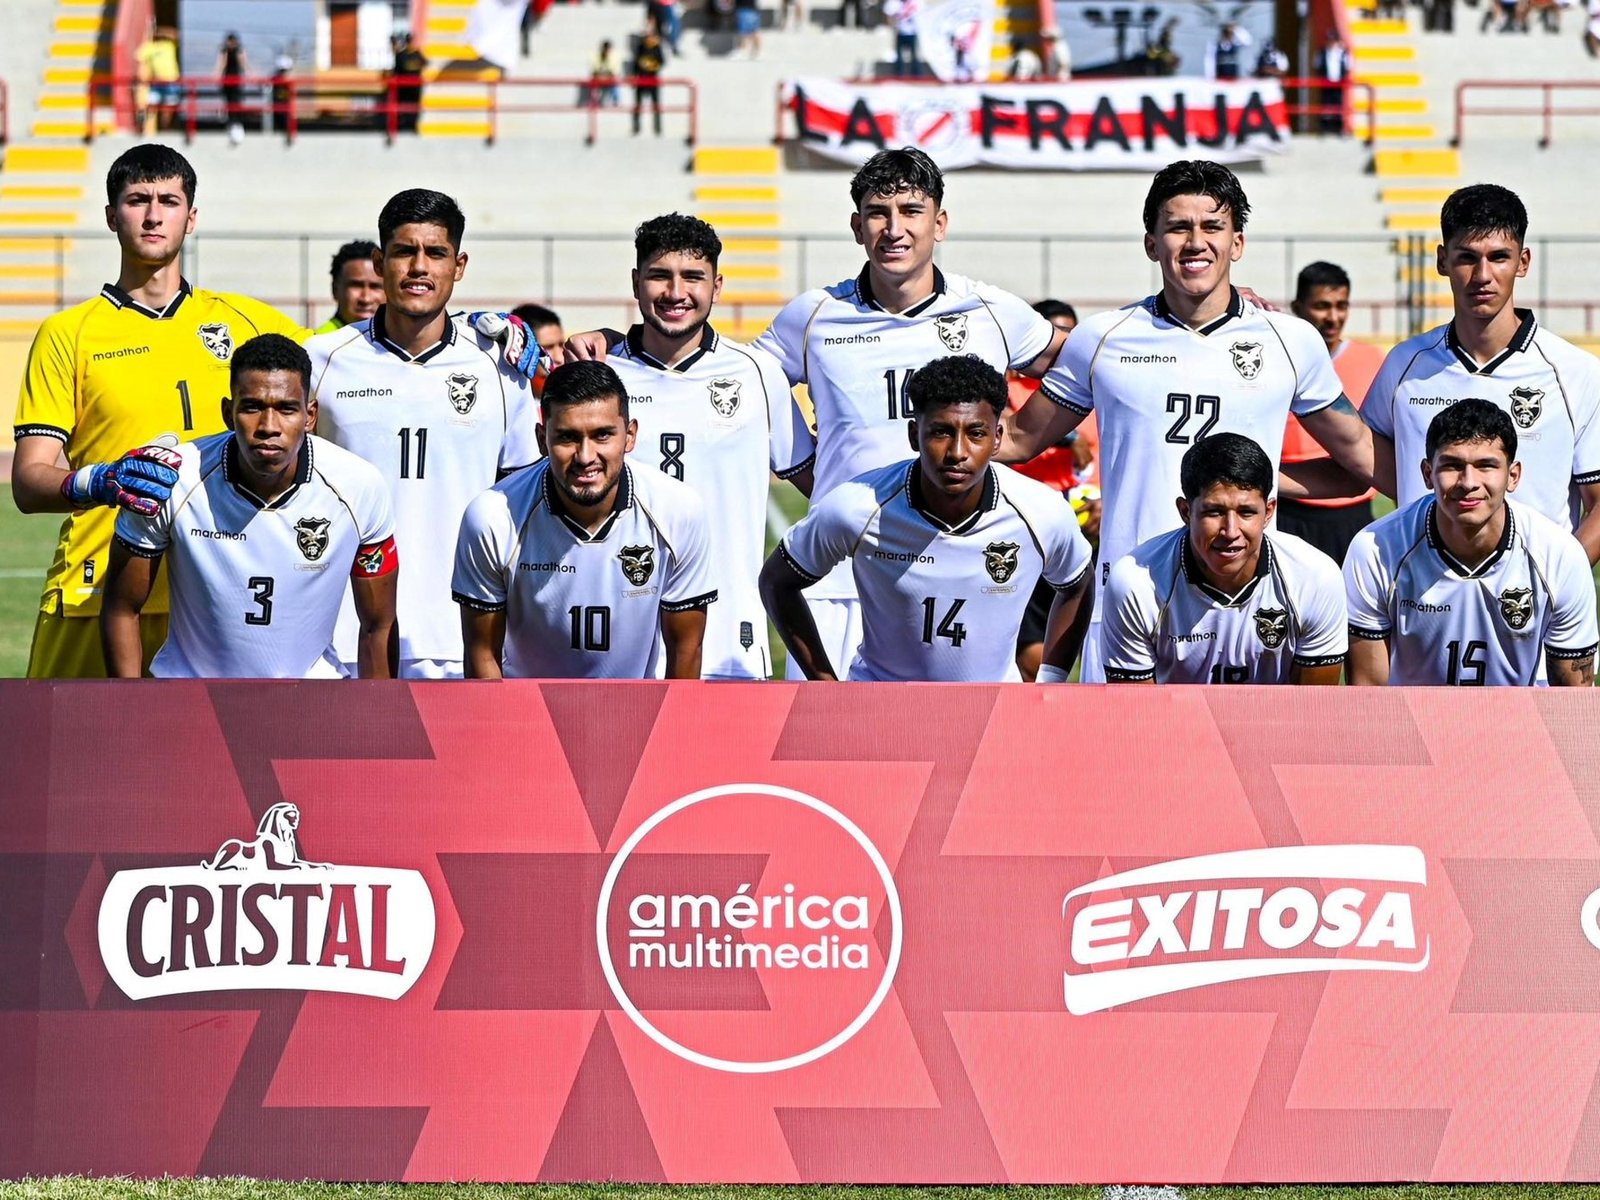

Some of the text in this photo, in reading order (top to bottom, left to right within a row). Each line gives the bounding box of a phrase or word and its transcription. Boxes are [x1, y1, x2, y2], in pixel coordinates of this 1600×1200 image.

[794, 83, 1281, 151] LA FRANJA
[93, 345, 150, 361] marathon
[824, 334, 881, 346] marathon
[1120, 354, 1177, 365] marathon
[175, 380, 194, 431] 1
[336, 387, 393, 399] marathon
[1165, 393, 1221, 444] 22
[398, 427, 428, 479] 11
[660, 432, 685, 482] 8
[190, 528, 247, 541] marathon
[874, 550, 935, 564] marathon
[519, 561, 576, 574] marathon
[245, 576, 274, 625] 3
[921, 597, 967, 647] 14
[1399, 599, 1451, 613] marathon
[568, 605, 611, 652] 10
[1446, 640, 1488, 686] 15
[127, 884, 407, 977] CRISTAL
[629, 882, 869, 932] américa
[1070, 886, 1416, 965] EXITOSA
[629, 934, 869, 970] multimedia
